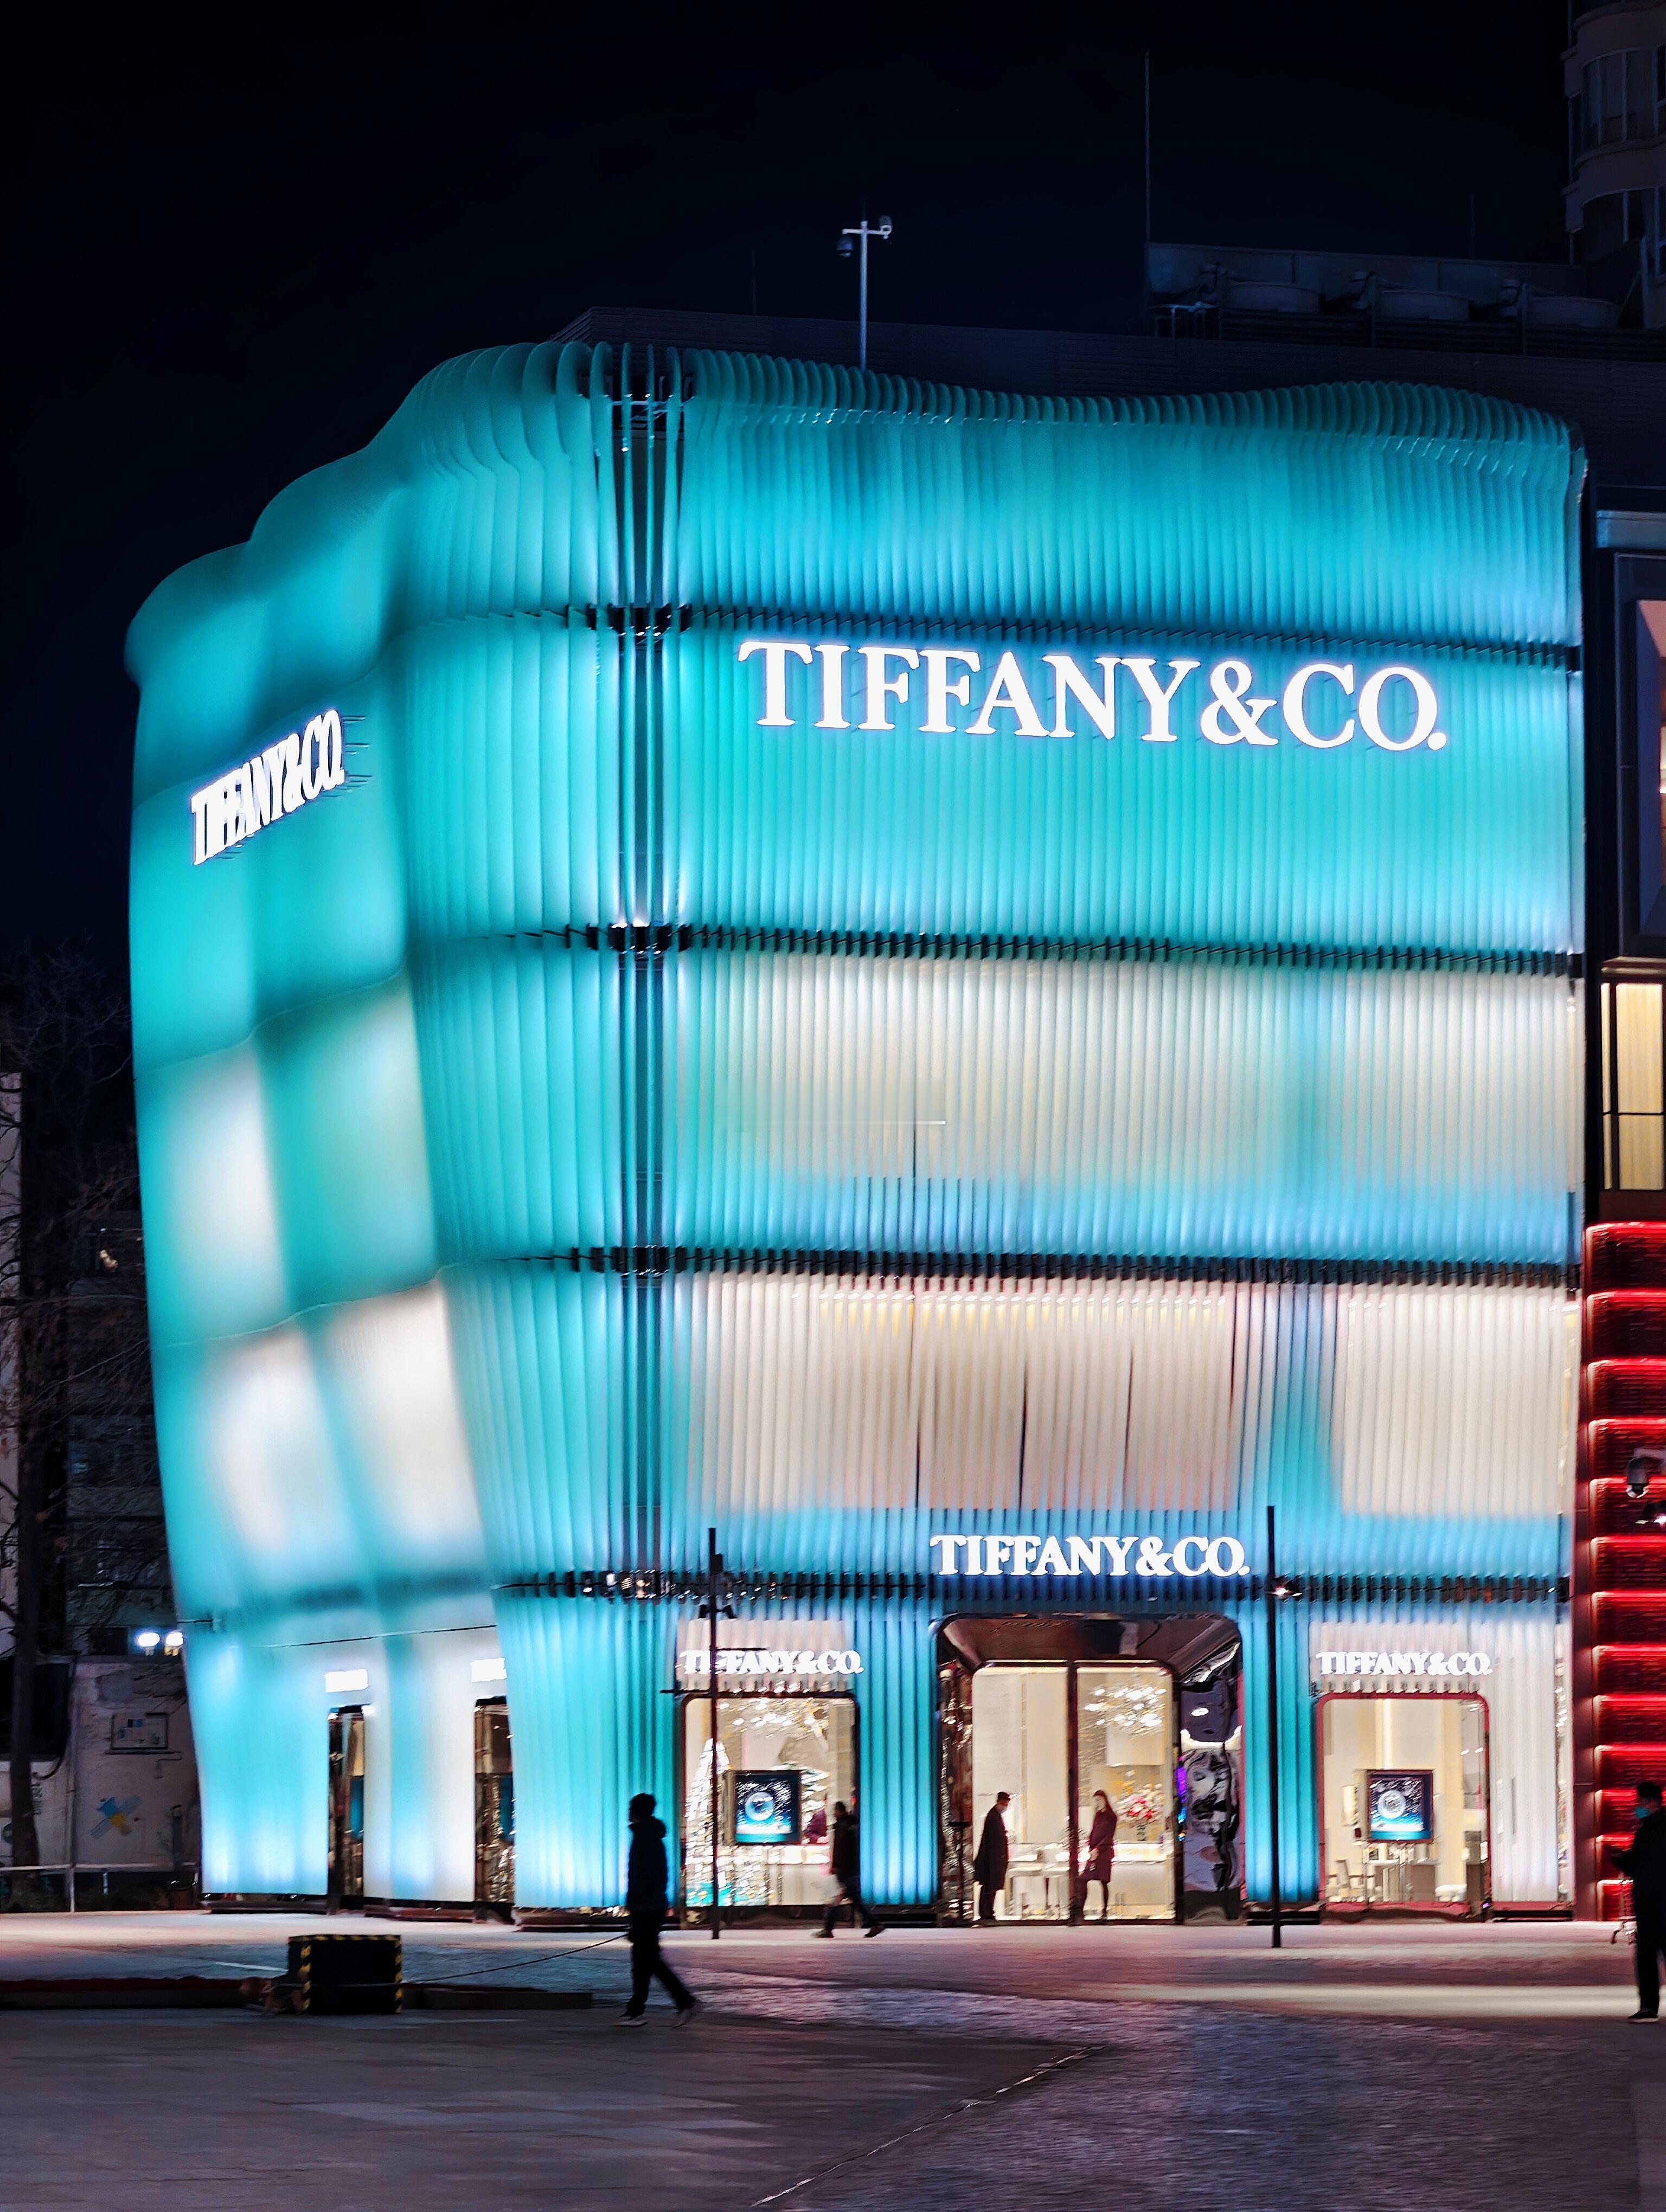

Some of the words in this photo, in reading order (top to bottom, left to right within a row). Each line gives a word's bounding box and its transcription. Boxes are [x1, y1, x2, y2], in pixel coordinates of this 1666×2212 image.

[738, 641, 1446, 751] TIFFANY&CO.
[930, 1535, 1250, 1577] TIFFANY&CO.
[1316, 1651, 1492, 1676] TIFFANY&CO.
